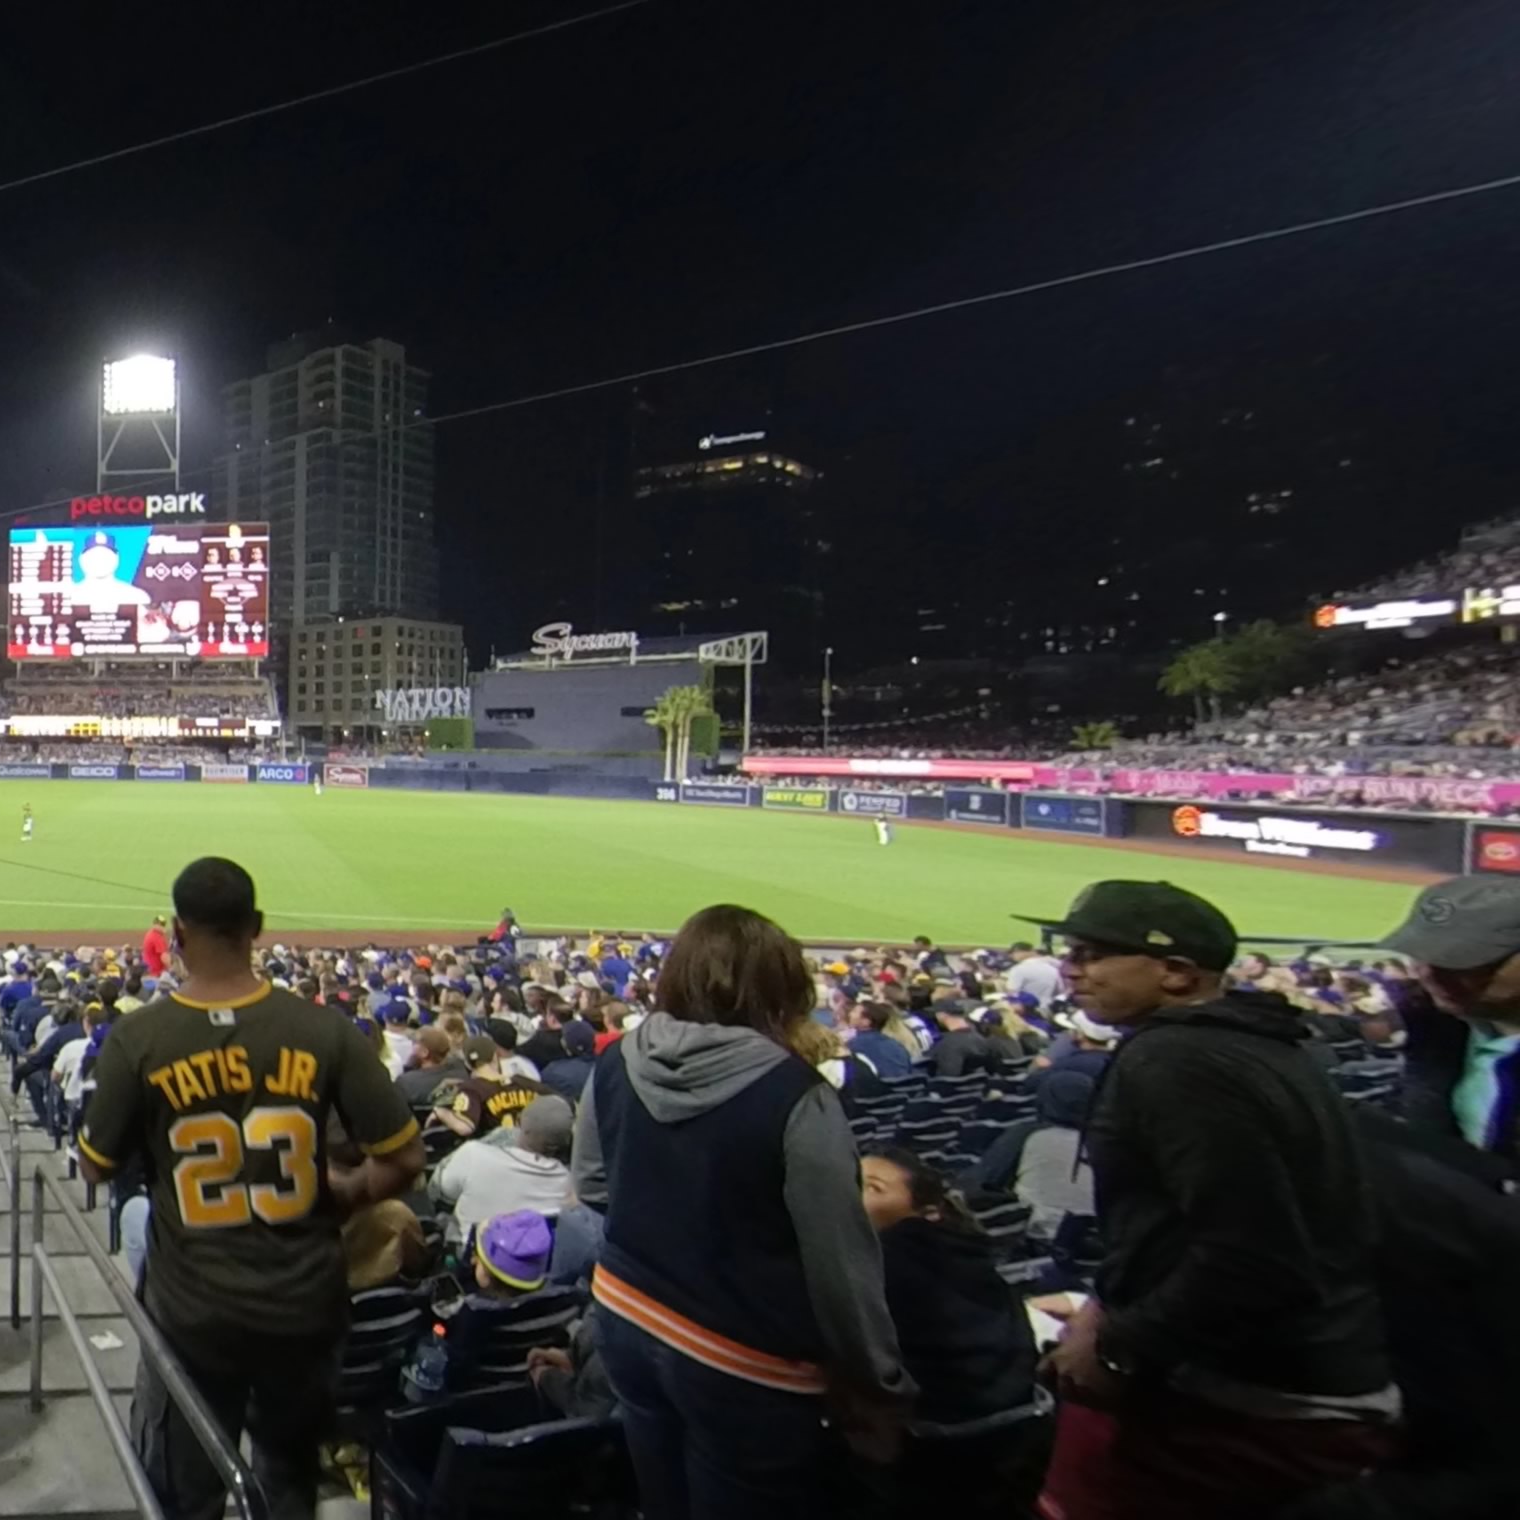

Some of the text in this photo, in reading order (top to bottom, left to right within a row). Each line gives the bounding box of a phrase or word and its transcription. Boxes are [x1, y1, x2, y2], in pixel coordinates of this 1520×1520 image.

[530, 622, 640, 661] Sycuan
[375, 687, 471, 708] NATION
[71, 767, 115, 777] GEICO
[259, 768, 293, 780] ARCO
[148, 1044, 320, 1111] TATIS JR.
[168, 1105, 318, 1230] 23
